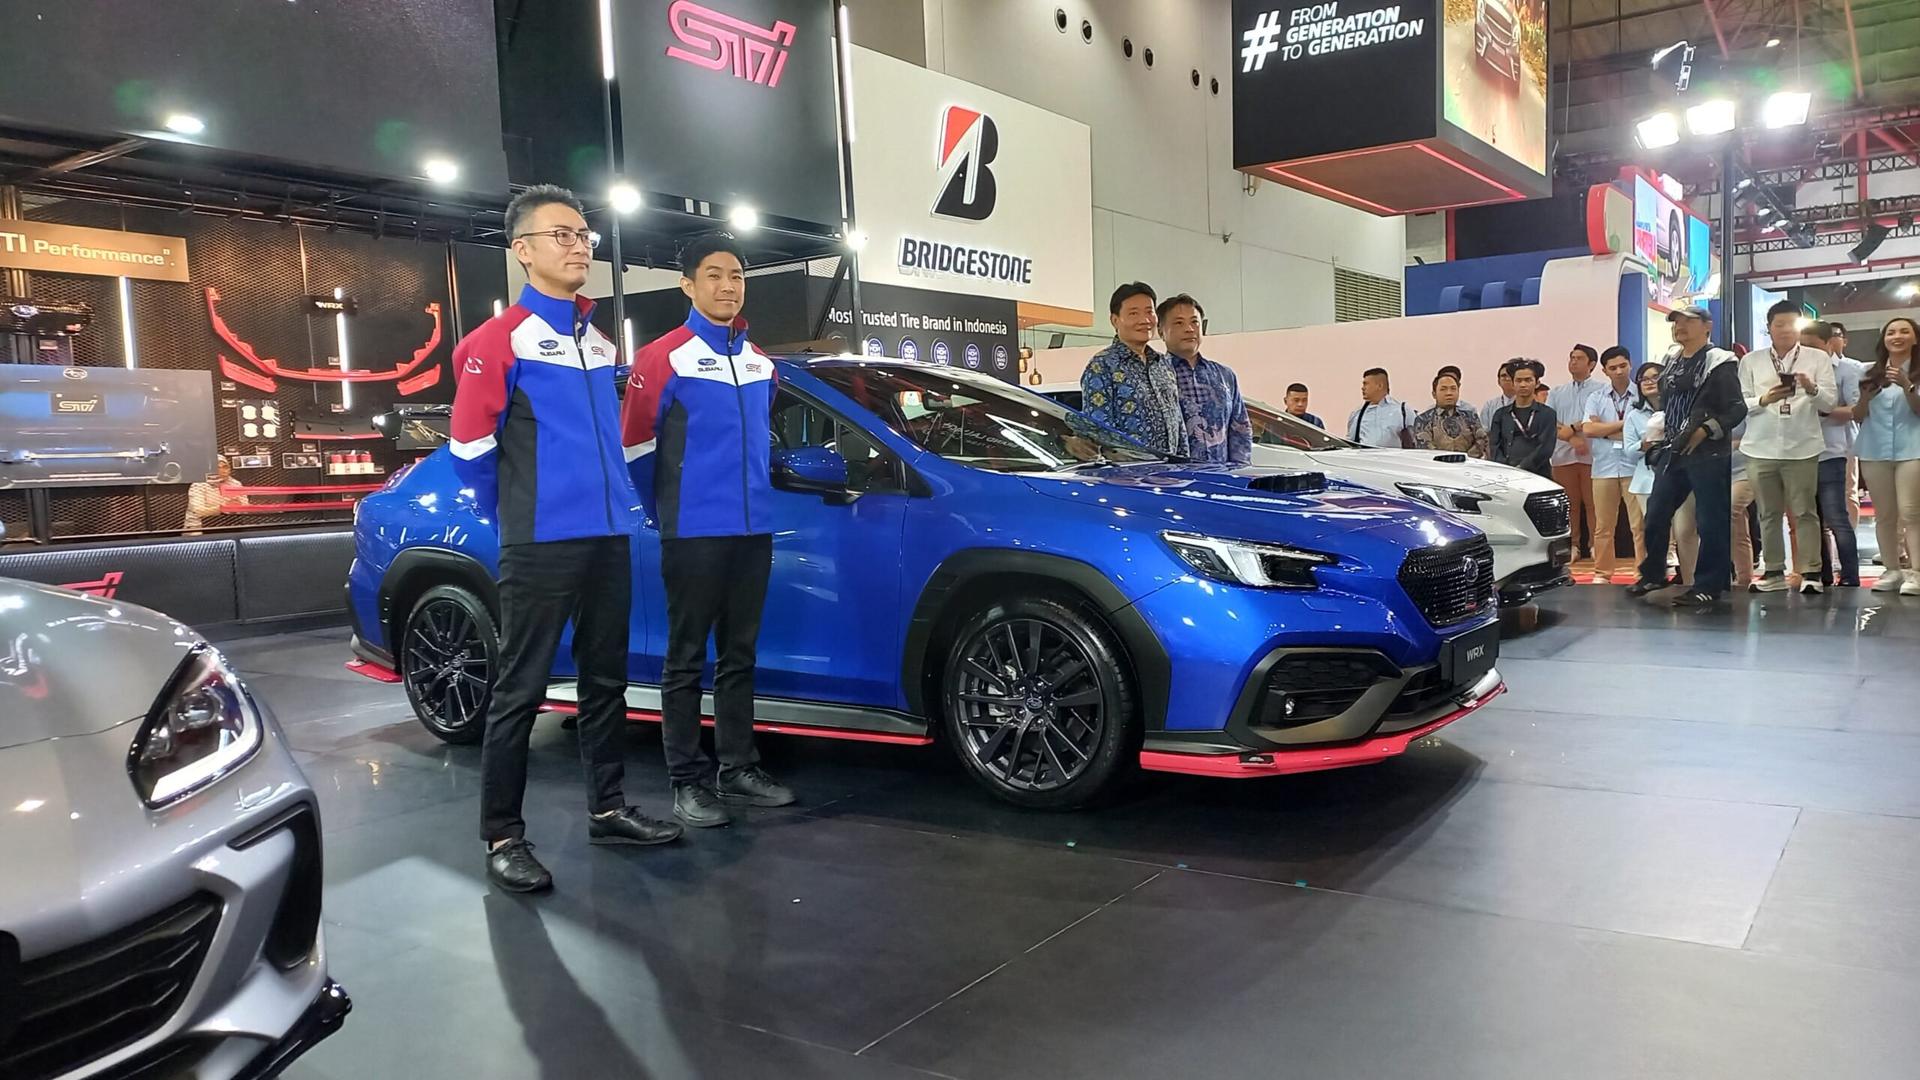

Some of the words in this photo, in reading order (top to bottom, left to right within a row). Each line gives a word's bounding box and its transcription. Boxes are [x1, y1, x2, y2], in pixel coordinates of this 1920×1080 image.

[1286, 6, 1401, 43] GENERATION
[1290, 1, 1338, 26] FROM
[1281, 44, 1303, 61] TO
[1308, 19, 1425, 56] GENERATION
[901, 237, 1033, 284] BRIDGESTONE
[860, 310, 898, 328] rusted
[900, 313, 920, 329] Tire
[922, 316, 951, 331] Brand
[953, 317, 963, 332] in
[964, 320, 1007, 335] Indonesia
[1466, 644, 1485, 662] WRX
